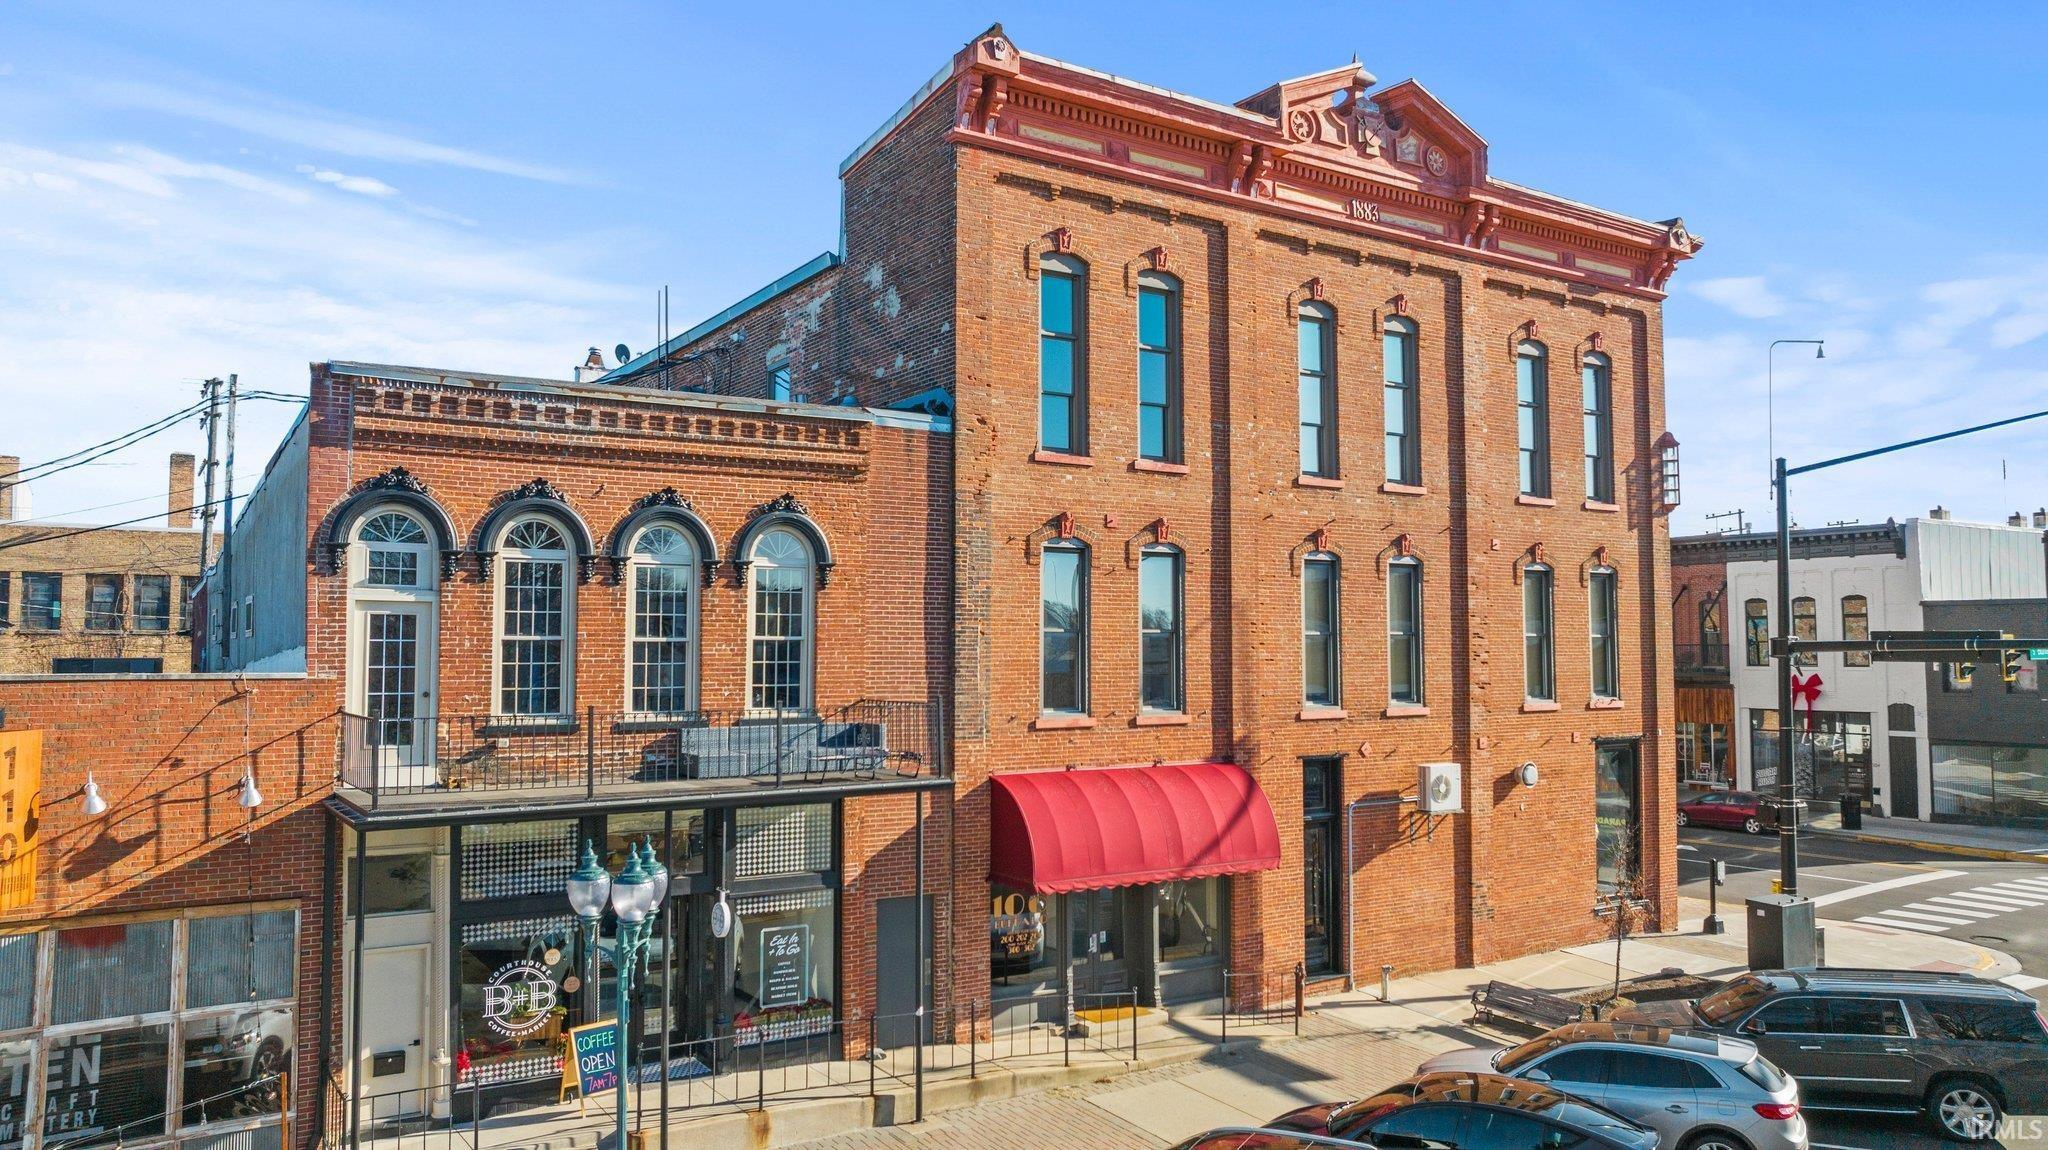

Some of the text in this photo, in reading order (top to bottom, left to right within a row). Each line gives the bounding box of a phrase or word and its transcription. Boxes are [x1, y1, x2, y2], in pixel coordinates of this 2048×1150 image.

[1352, 199, 1379, 222] 1883
[488, 959, 553, 984] COURTHOUSE
[577, 1030, 615, 1053] COFFEE
[581, 1049, 616, 1072] OPEN
[584, 1071, 618, 1092] 7AM-7P
[1, 1089, 99, 1121] CAFT
